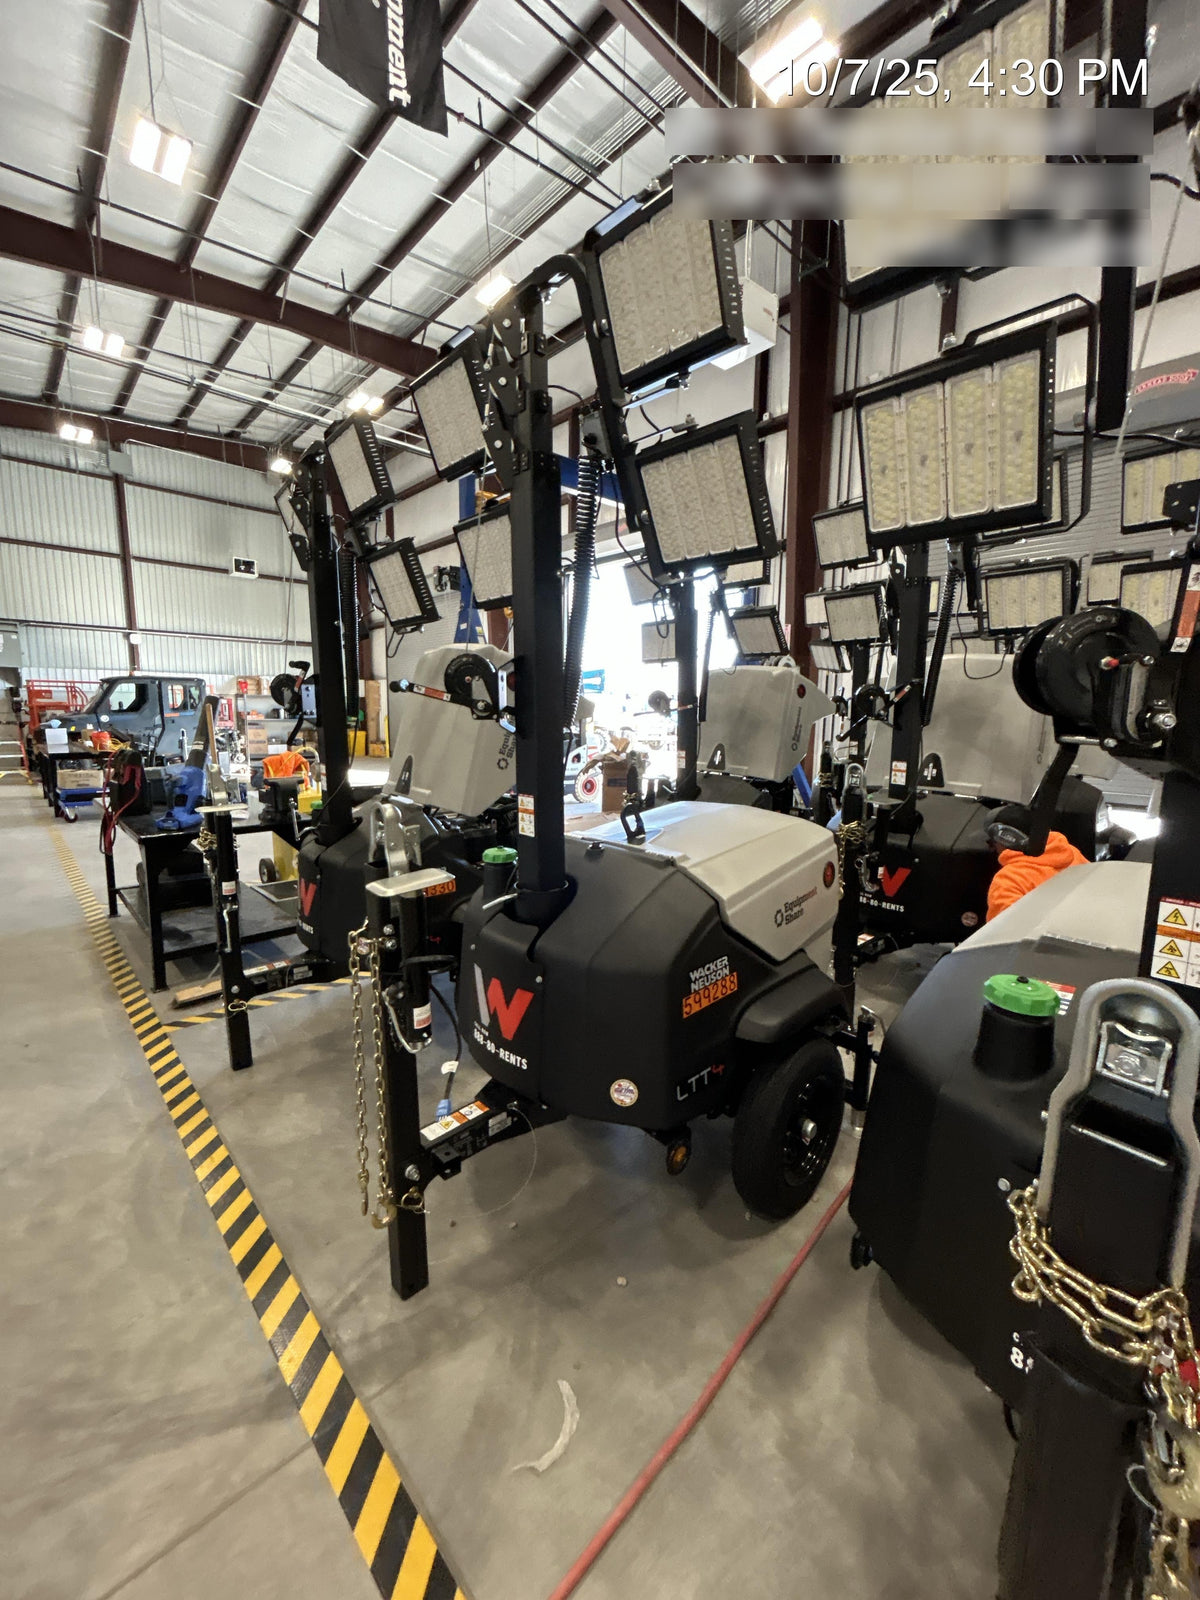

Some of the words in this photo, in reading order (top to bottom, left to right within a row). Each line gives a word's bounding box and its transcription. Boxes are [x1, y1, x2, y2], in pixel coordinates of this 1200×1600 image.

[689, 956, 729, 982] WACKER
[690, 966, 730, 993] NEUSON
[683, 974, 738, 1016] 599288
